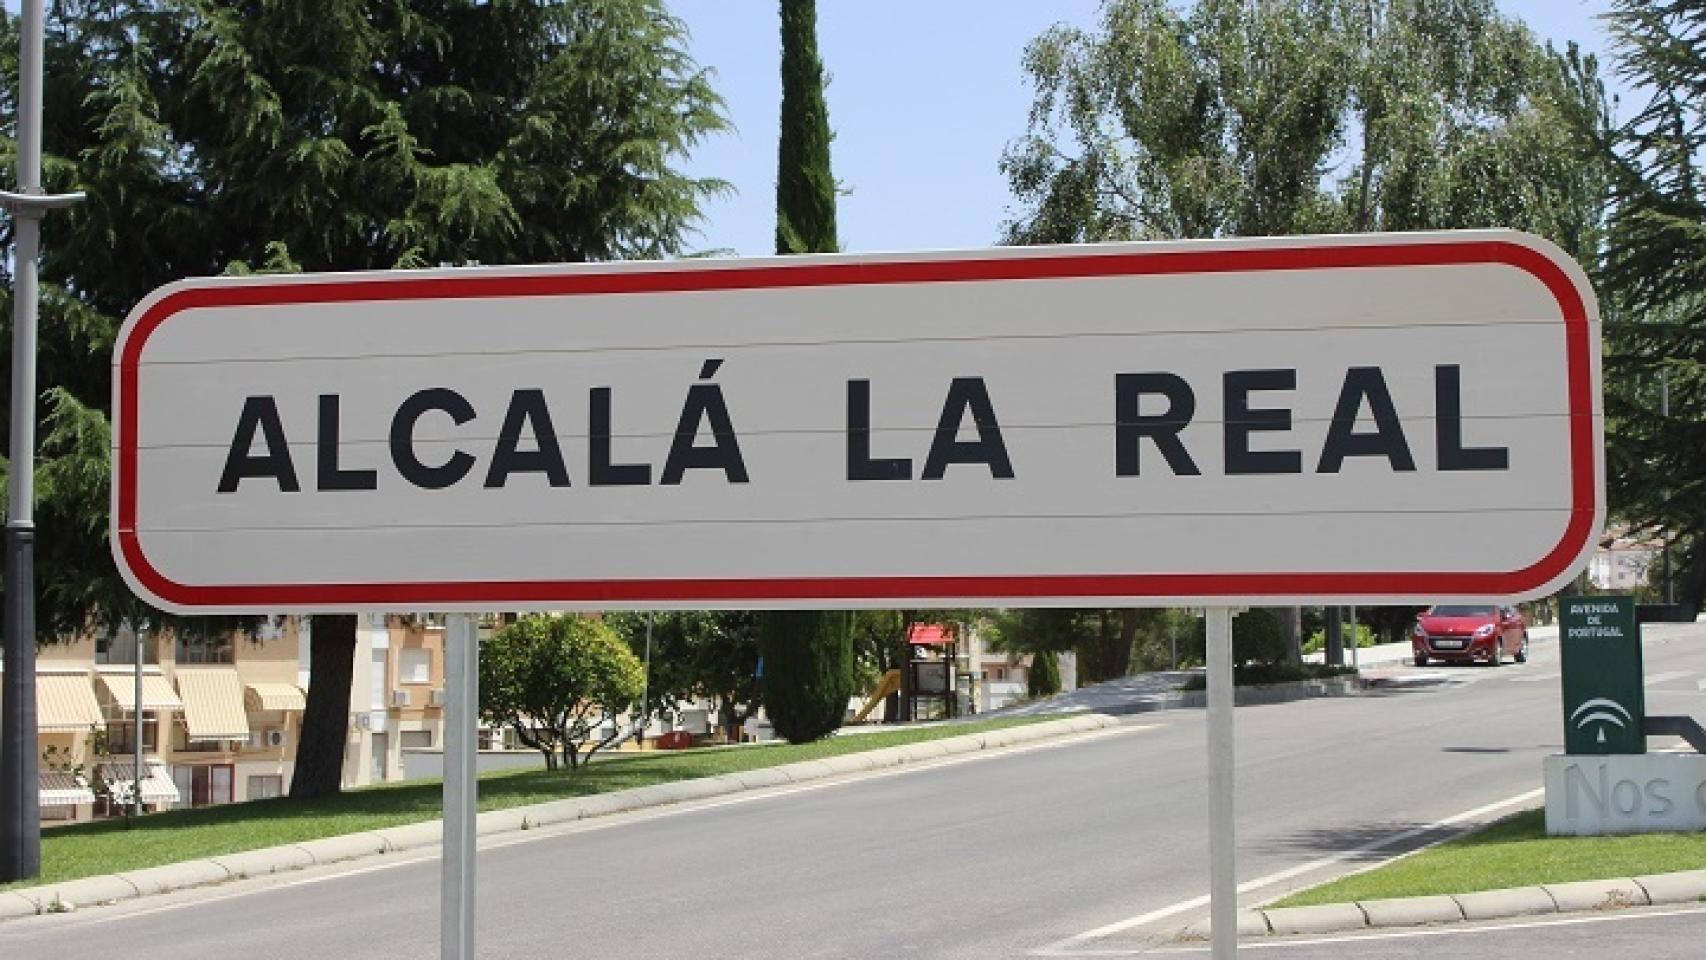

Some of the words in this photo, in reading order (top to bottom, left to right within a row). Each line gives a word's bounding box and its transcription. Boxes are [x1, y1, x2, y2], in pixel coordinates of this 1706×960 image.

[216, 358, 750, 494] ALCALÁ
[845, 375, 1015, 481] LA
[1115, 364, 1511, 478] REAL
[1570, 602, 1619, 614] AVENIDA
[1587, 616, 1602, 625] DE
[1568, 626, 1624, 638] PORTUGAL
